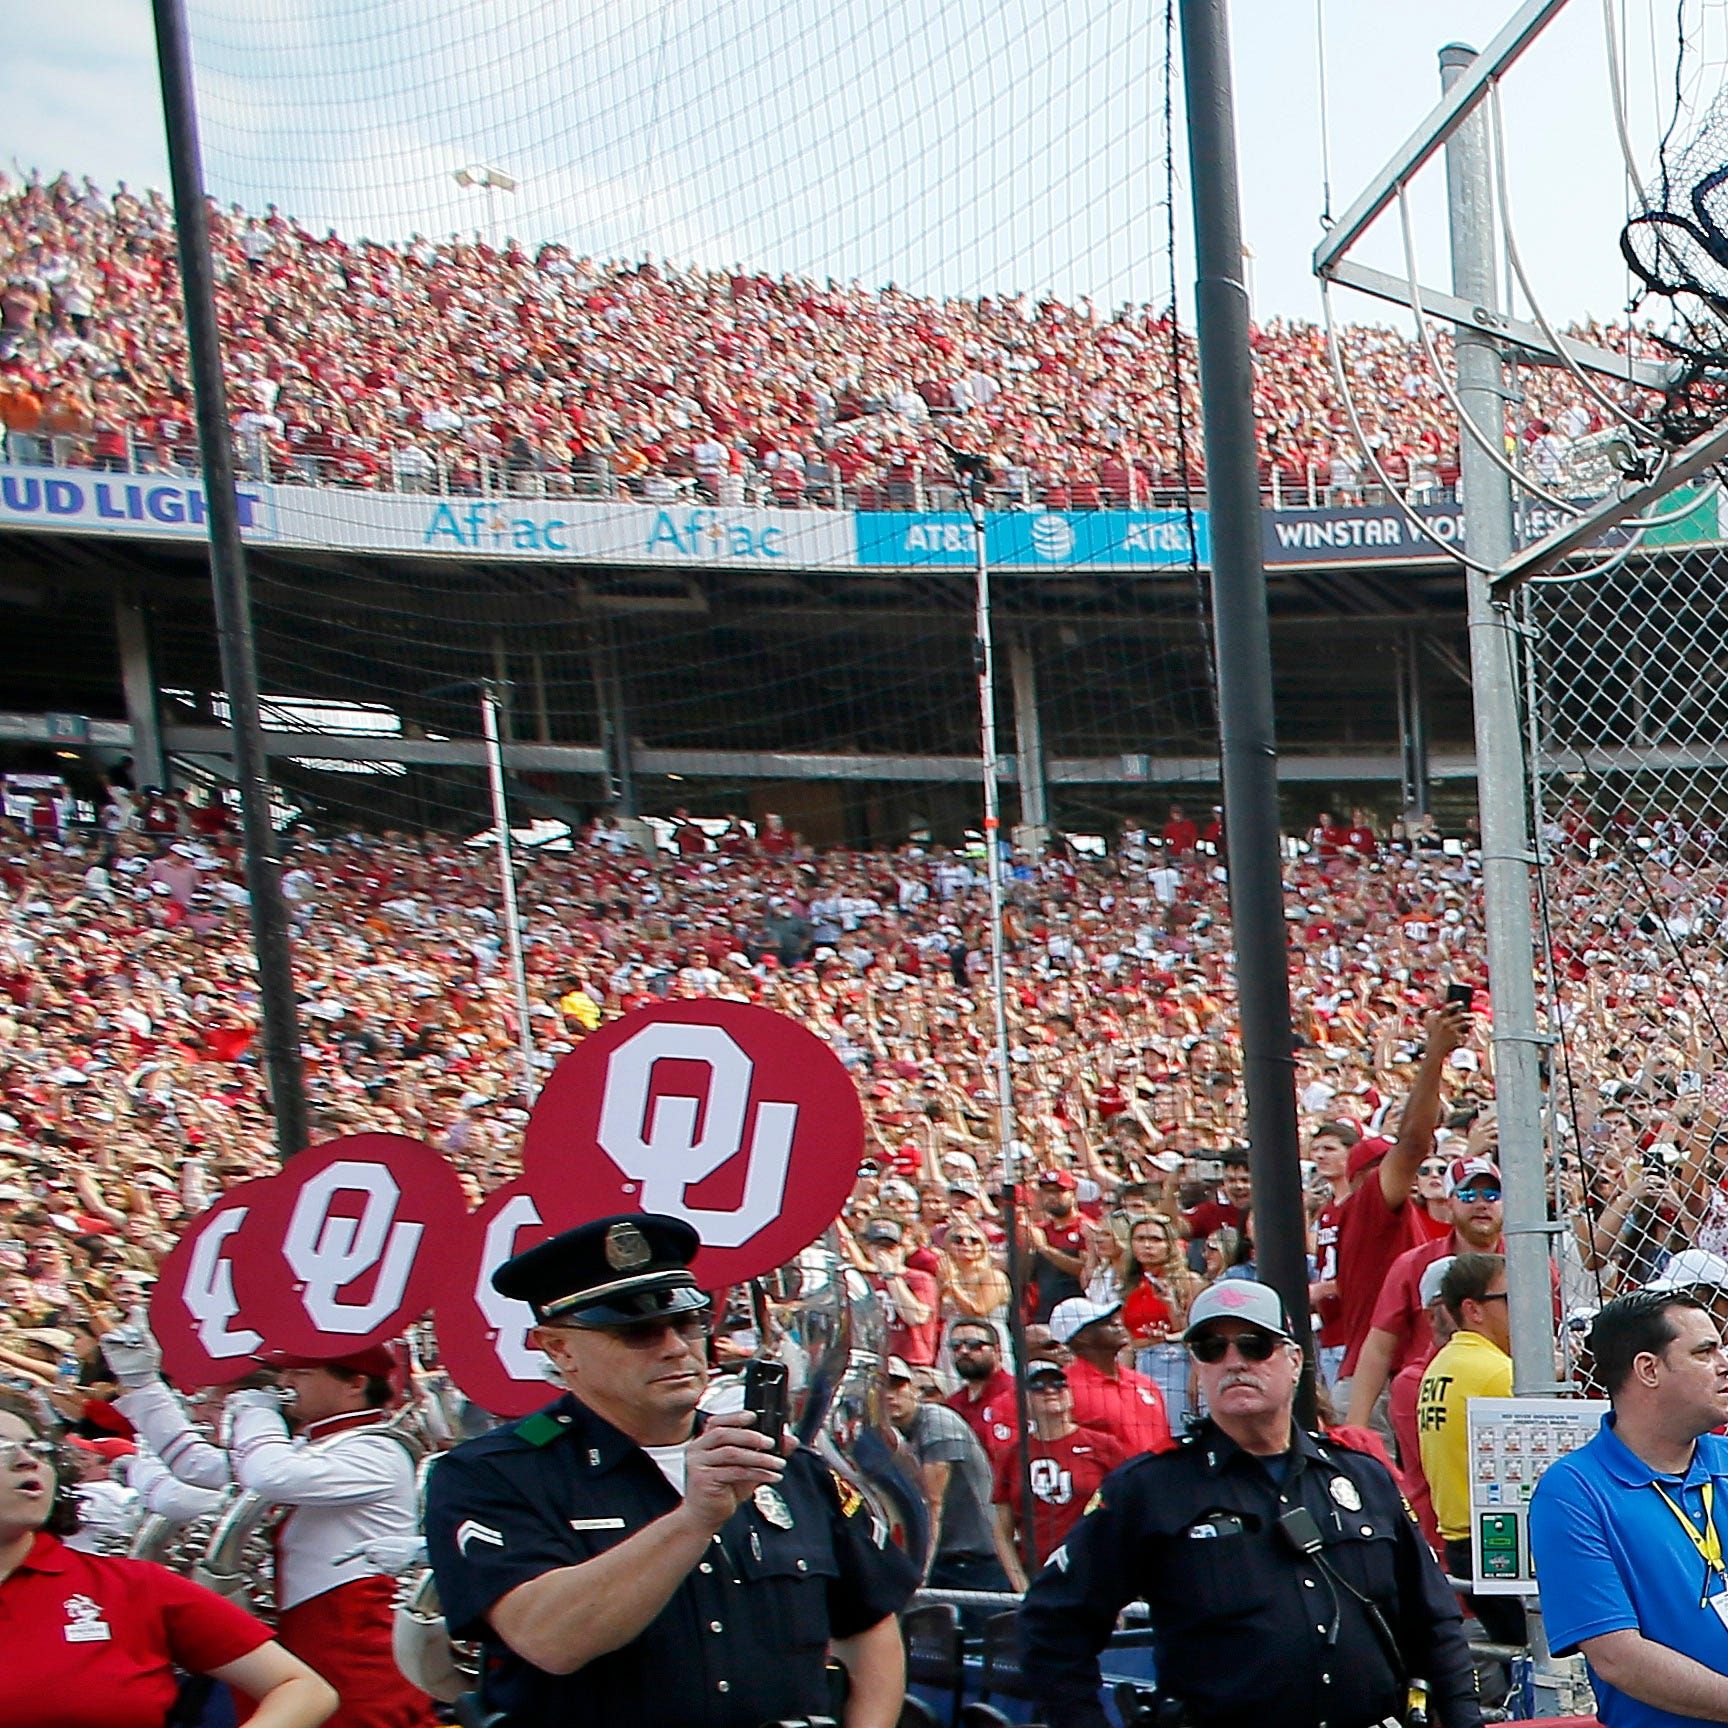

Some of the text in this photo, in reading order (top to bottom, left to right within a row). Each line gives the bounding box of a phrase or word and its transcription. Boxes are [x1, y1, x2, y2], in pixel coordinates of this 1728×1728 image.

[1275, 518, 1401, 550] WINSTAR
[597, 1021, 799, 1248] OU
[282, 1160, 426, 1335] OU
[1029, 1457, 1073, 1505] OU
